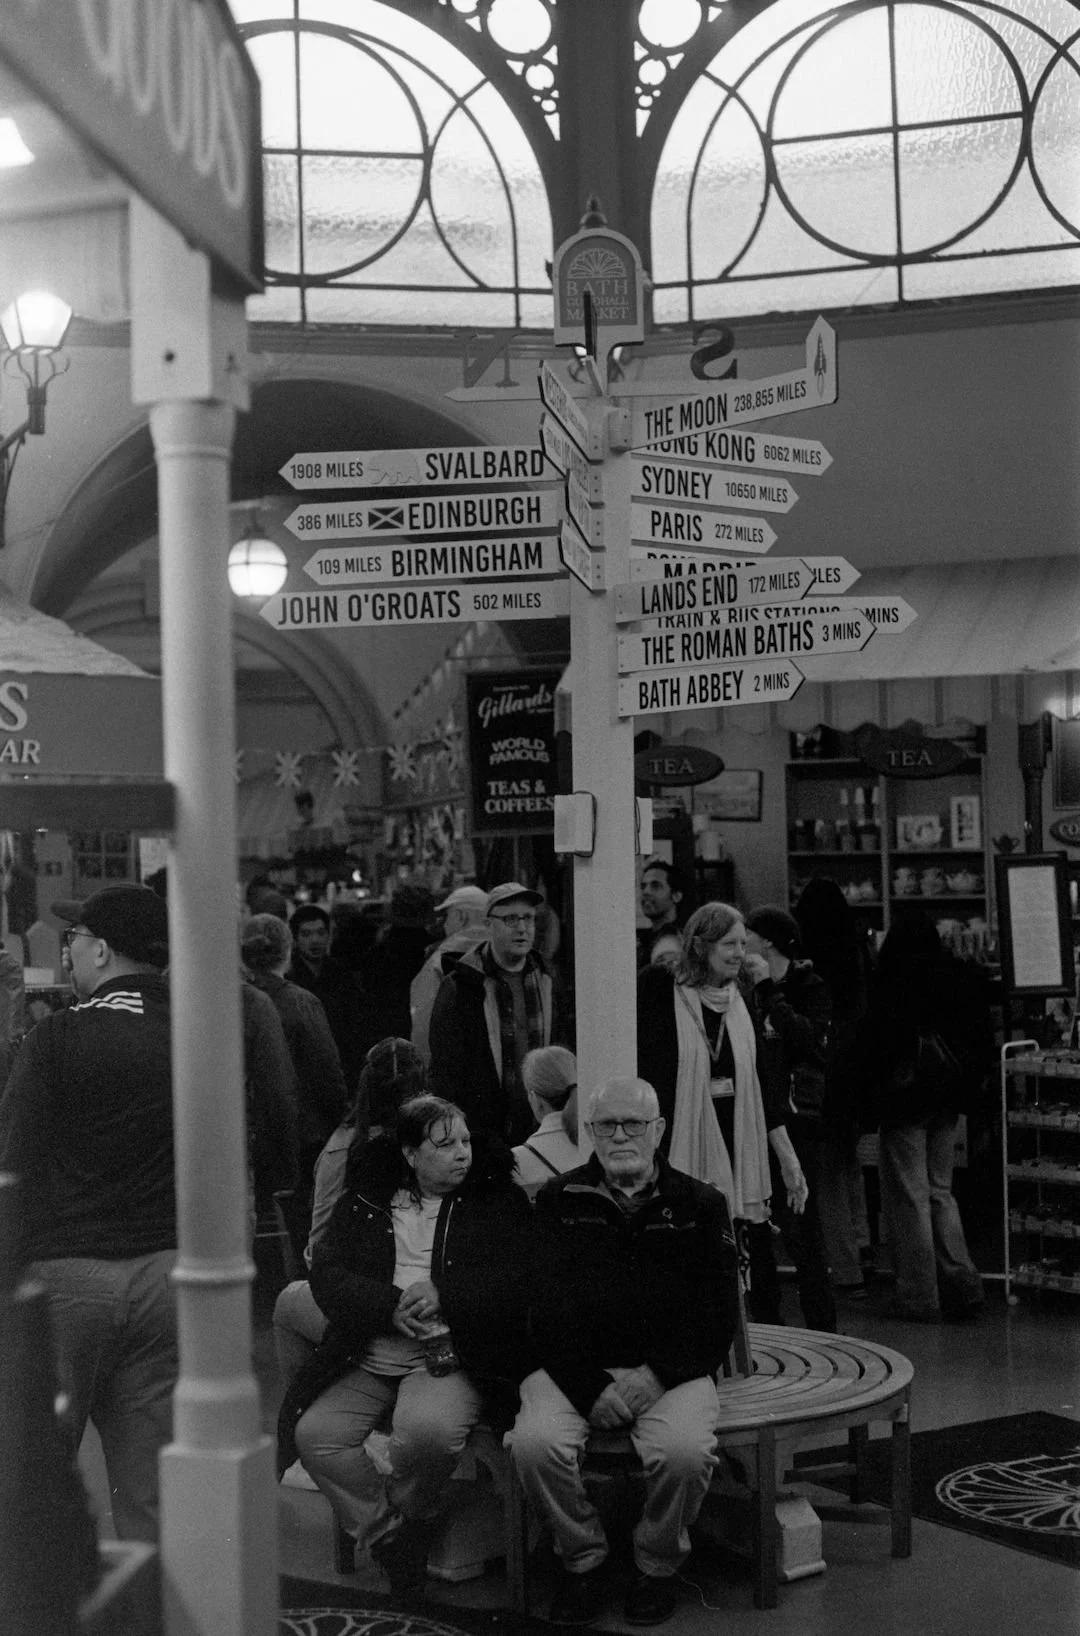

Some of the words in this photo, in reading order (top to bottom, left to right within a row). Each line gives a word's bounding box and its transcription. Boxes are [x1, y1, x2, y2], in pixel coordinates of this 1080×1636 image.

[567, 279, 628, 297] BATH
[644, 406, 674, 440] THE
[680, 393, 728, 432] MOON
[734, 388, 774, 413] 238,855
[777, 380, 807, 403] MILES
[291, 463, 322, 480] 1908
[326, 462, 364, 479] MILES
[426, 450, 544, 481] SVALBARD
[705, 431, 755, 463] KONG
[763, 444, 789, 462] 6062
[792, 449, 822, 466] MILES
[641, 464, 713, 500] SYDNEY
[725, 481, 757, 500] 10650
[759, 485, 788, 504] MILES
[297, 515, 322, 531] 386
[326, 512, 363, 529] MILES
[408, 496, 541, 530] EDINBURGH
[651, 510, 703, 542] PARIS
[715, 523, 733, 540] 272
[735, 526, 764, 544] MILES
[318, 559, 341, 575] 109
[345, 557, 382, 574] MILES
[391, 541, 543, 577] BIRMINGHAM
[278, 595, 338, 625] JOHN
[348, 590, 460, 622] O'GROATS
[473, 594, 498, 611] 502
[503, 593, 542, 609] MILES
[641, 579, 697, 615] LANDS
[703, 573, 738, 606] END
[748, 576, 766, 593] 172
[769, 571, 800, 591] MILES
[865, 607, 899, 623] MINS
[642, 635, 675, 665] THE
[681, 626, 747, 662] ROMAN
[754, 619, 814, 655] BATHS
[822, 625, 829, 642] 3
[833, 621, 861, 640] MINS
[478, 684, 553, 728] Gillards
[639, 678, 680, 710] BATH
[686, 670, 743, 705] ABBEY
[754, 675, 761, 692] 2
[764, 672, 790, 691] MINS
[490, 749, 550, 765] FAMOUS
[492, 737, 546, 752] WORLD
[887, 750, 933, 767] TEA
[649, 759, 694, 775] TEA
[487, 780, 531, 796] TEAS
[534, 779, 546, 794] &
[484, 797, 555, 814] COFFEES
